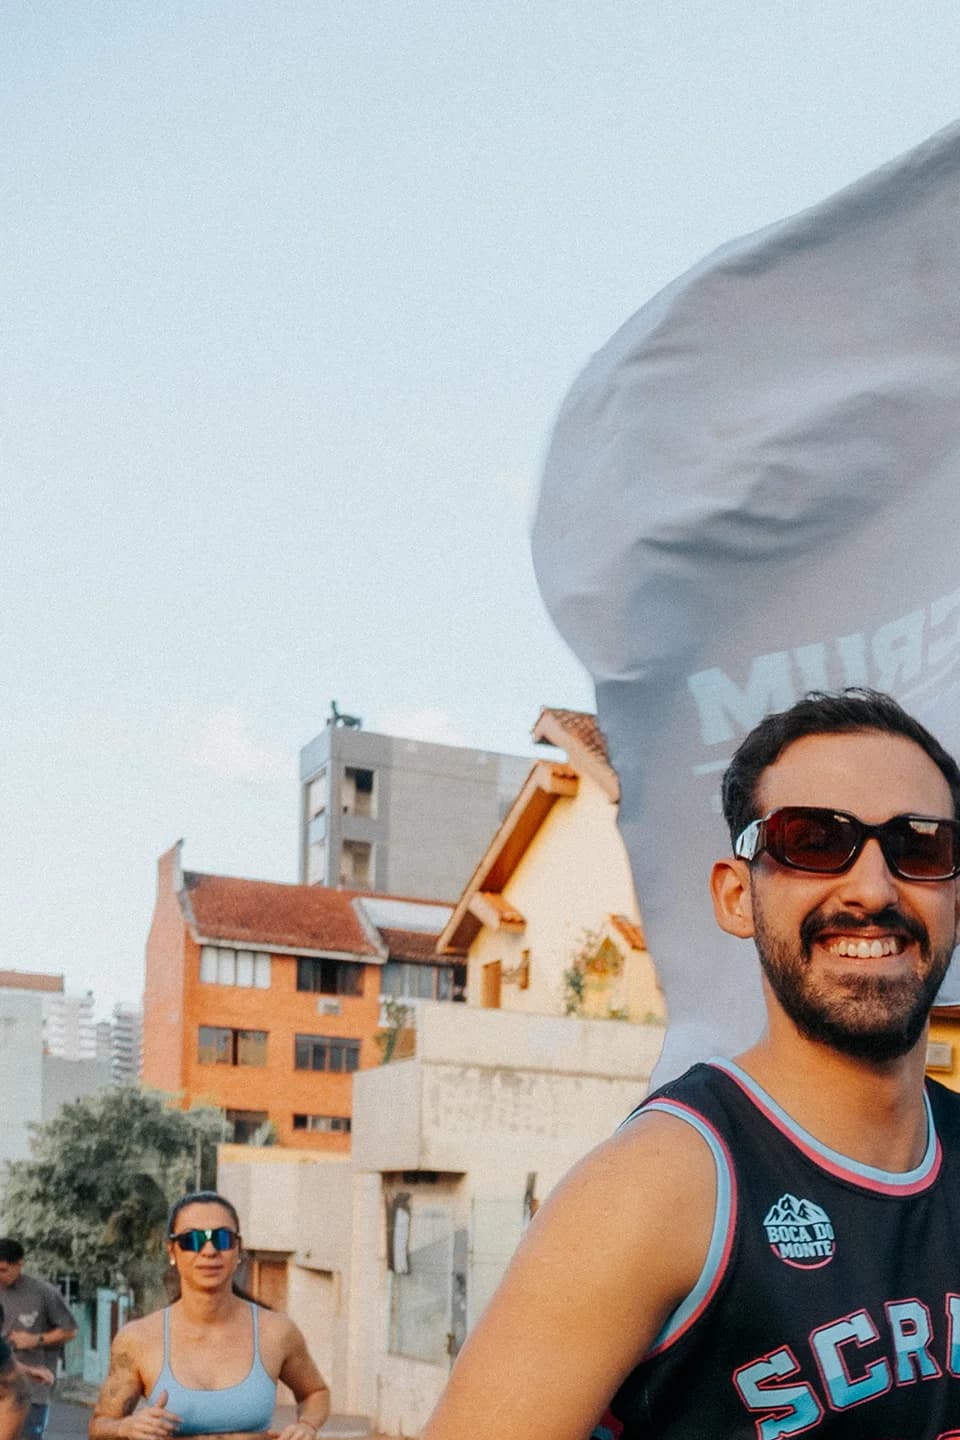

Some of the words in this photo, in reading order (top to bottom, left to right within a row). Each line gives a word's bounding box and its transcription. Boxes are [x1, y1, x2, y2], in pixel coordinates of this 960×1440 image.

[766, 1226, 812, 1243] BOCA
[812, 1223, 835, 1240] DO
[778, 1240, 833, 1258] MONTE
